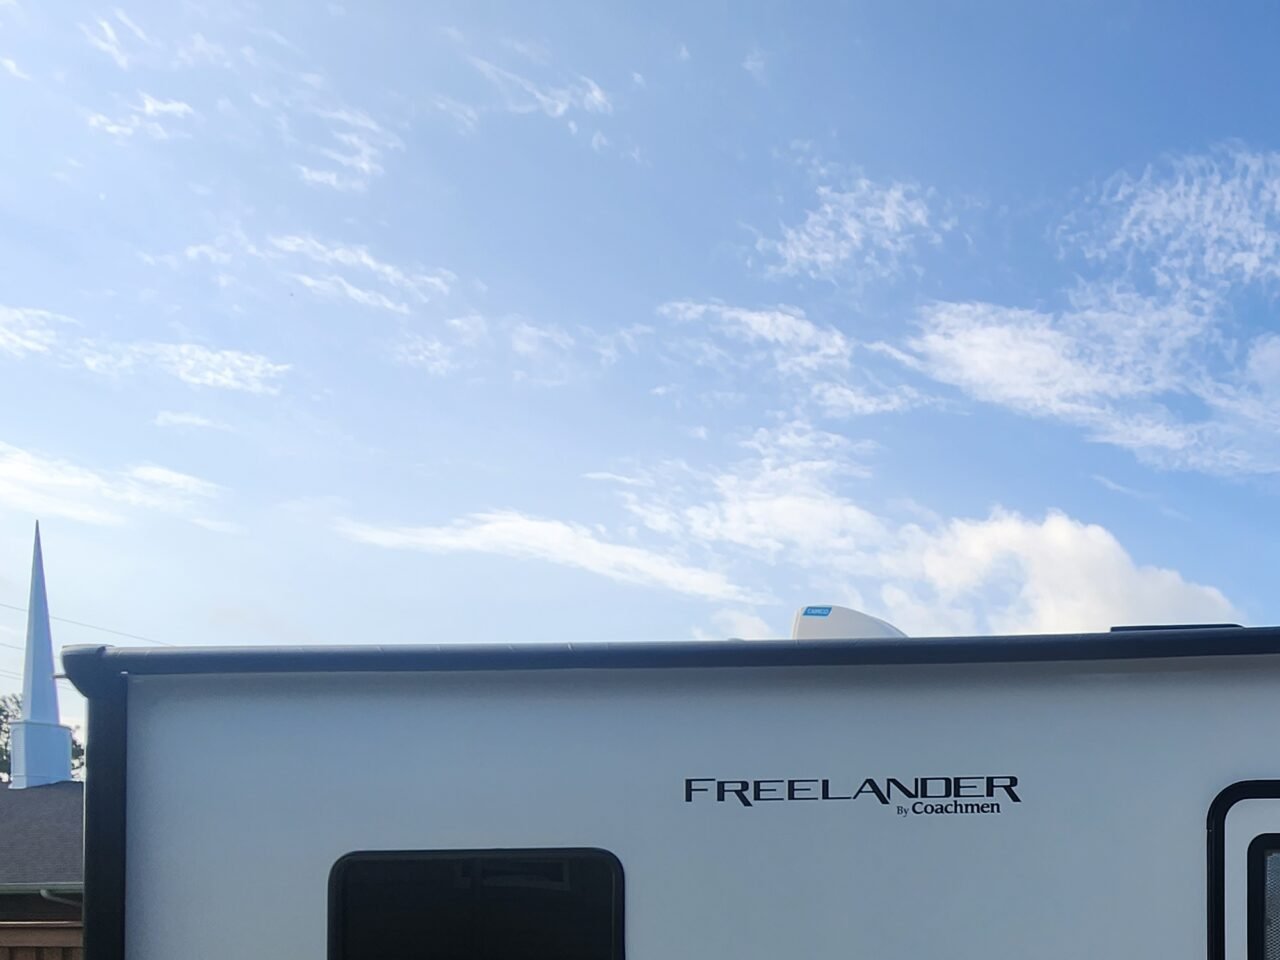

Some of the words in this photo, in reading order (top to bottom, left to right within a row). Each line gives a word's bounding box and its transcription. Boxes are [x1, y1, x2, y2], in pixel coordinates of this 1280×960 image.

[684, 775, 1022, 807] FREELANDER
[896, 806, 909, 818] By
[911, 800, 1001, 815] Coachmen
